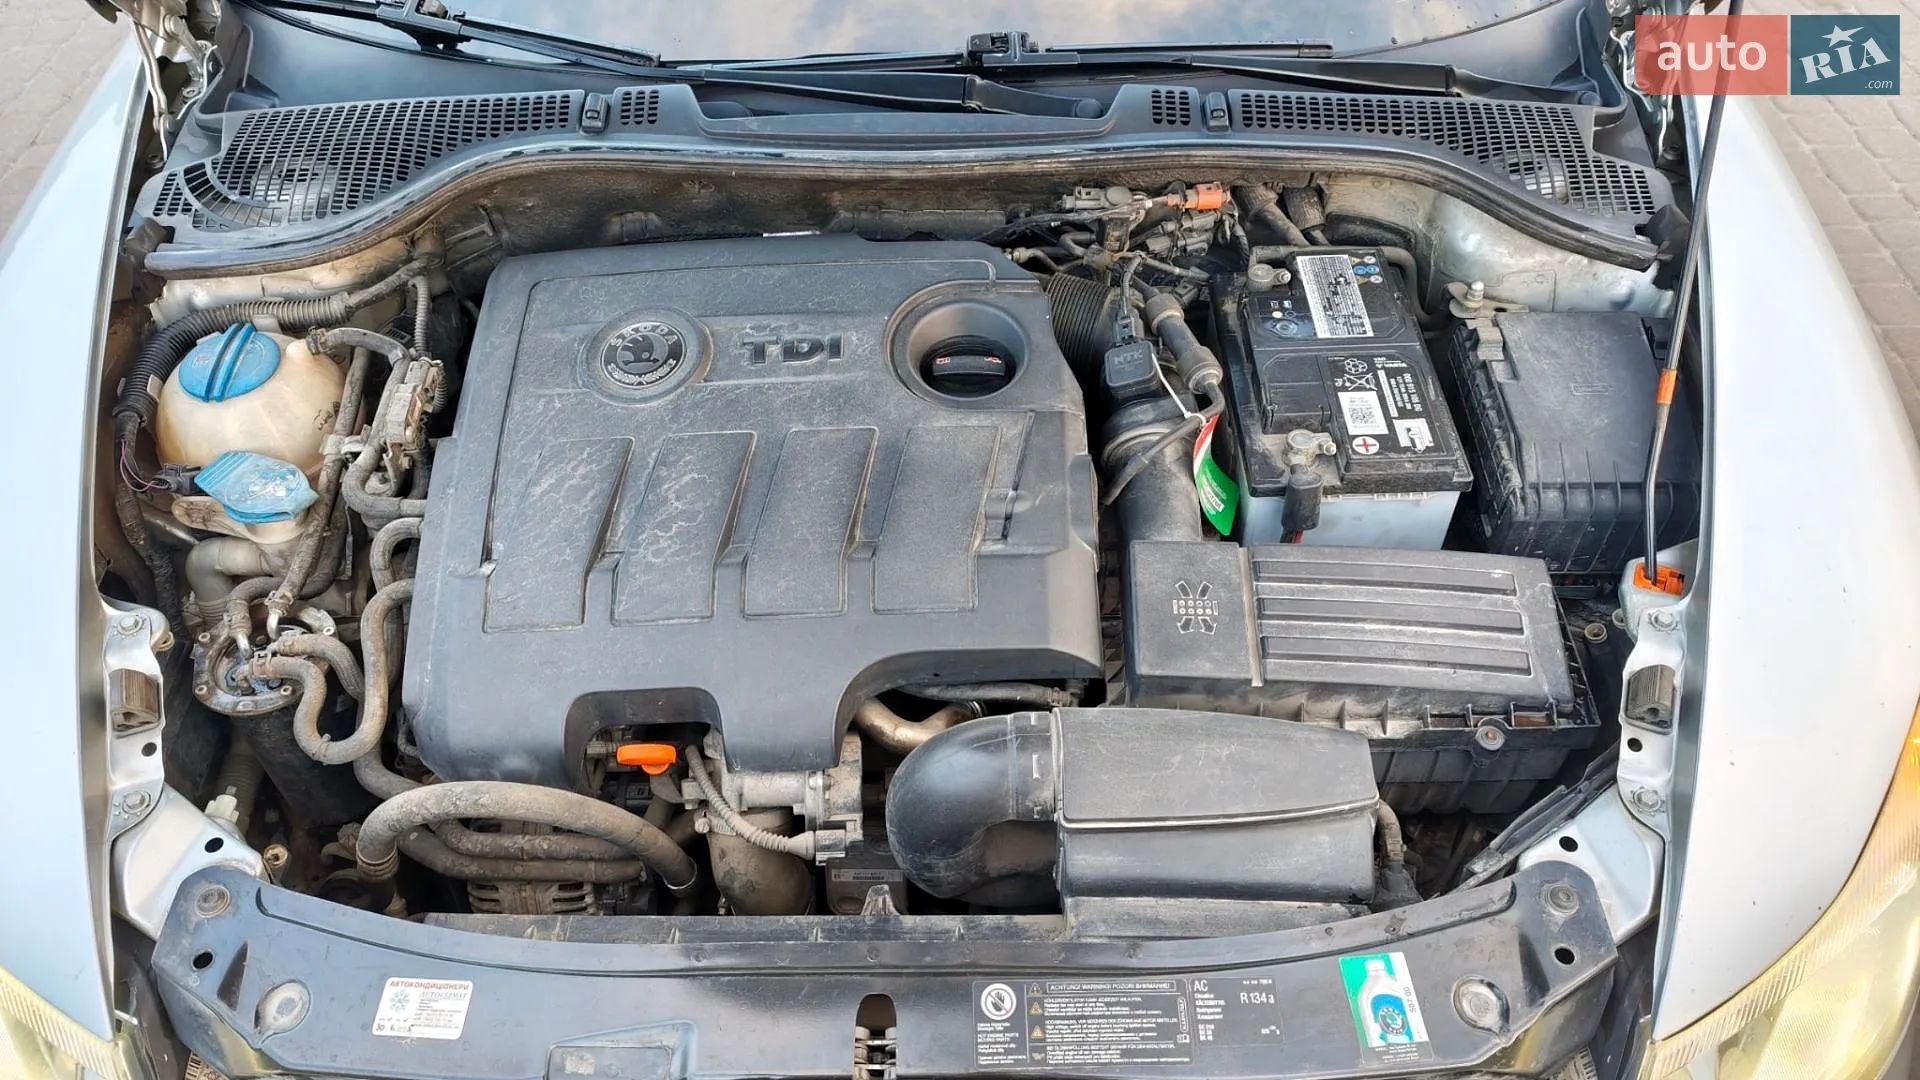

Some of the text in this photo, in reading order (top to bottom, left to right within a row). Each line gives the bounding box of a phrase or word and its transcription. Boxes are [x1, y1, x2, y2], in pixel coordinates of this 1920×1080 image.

[742, 332, 844, 365] TDI
[1114, 350, 1143, 365] NTK
[1194, 980, 1209, 991] AC
